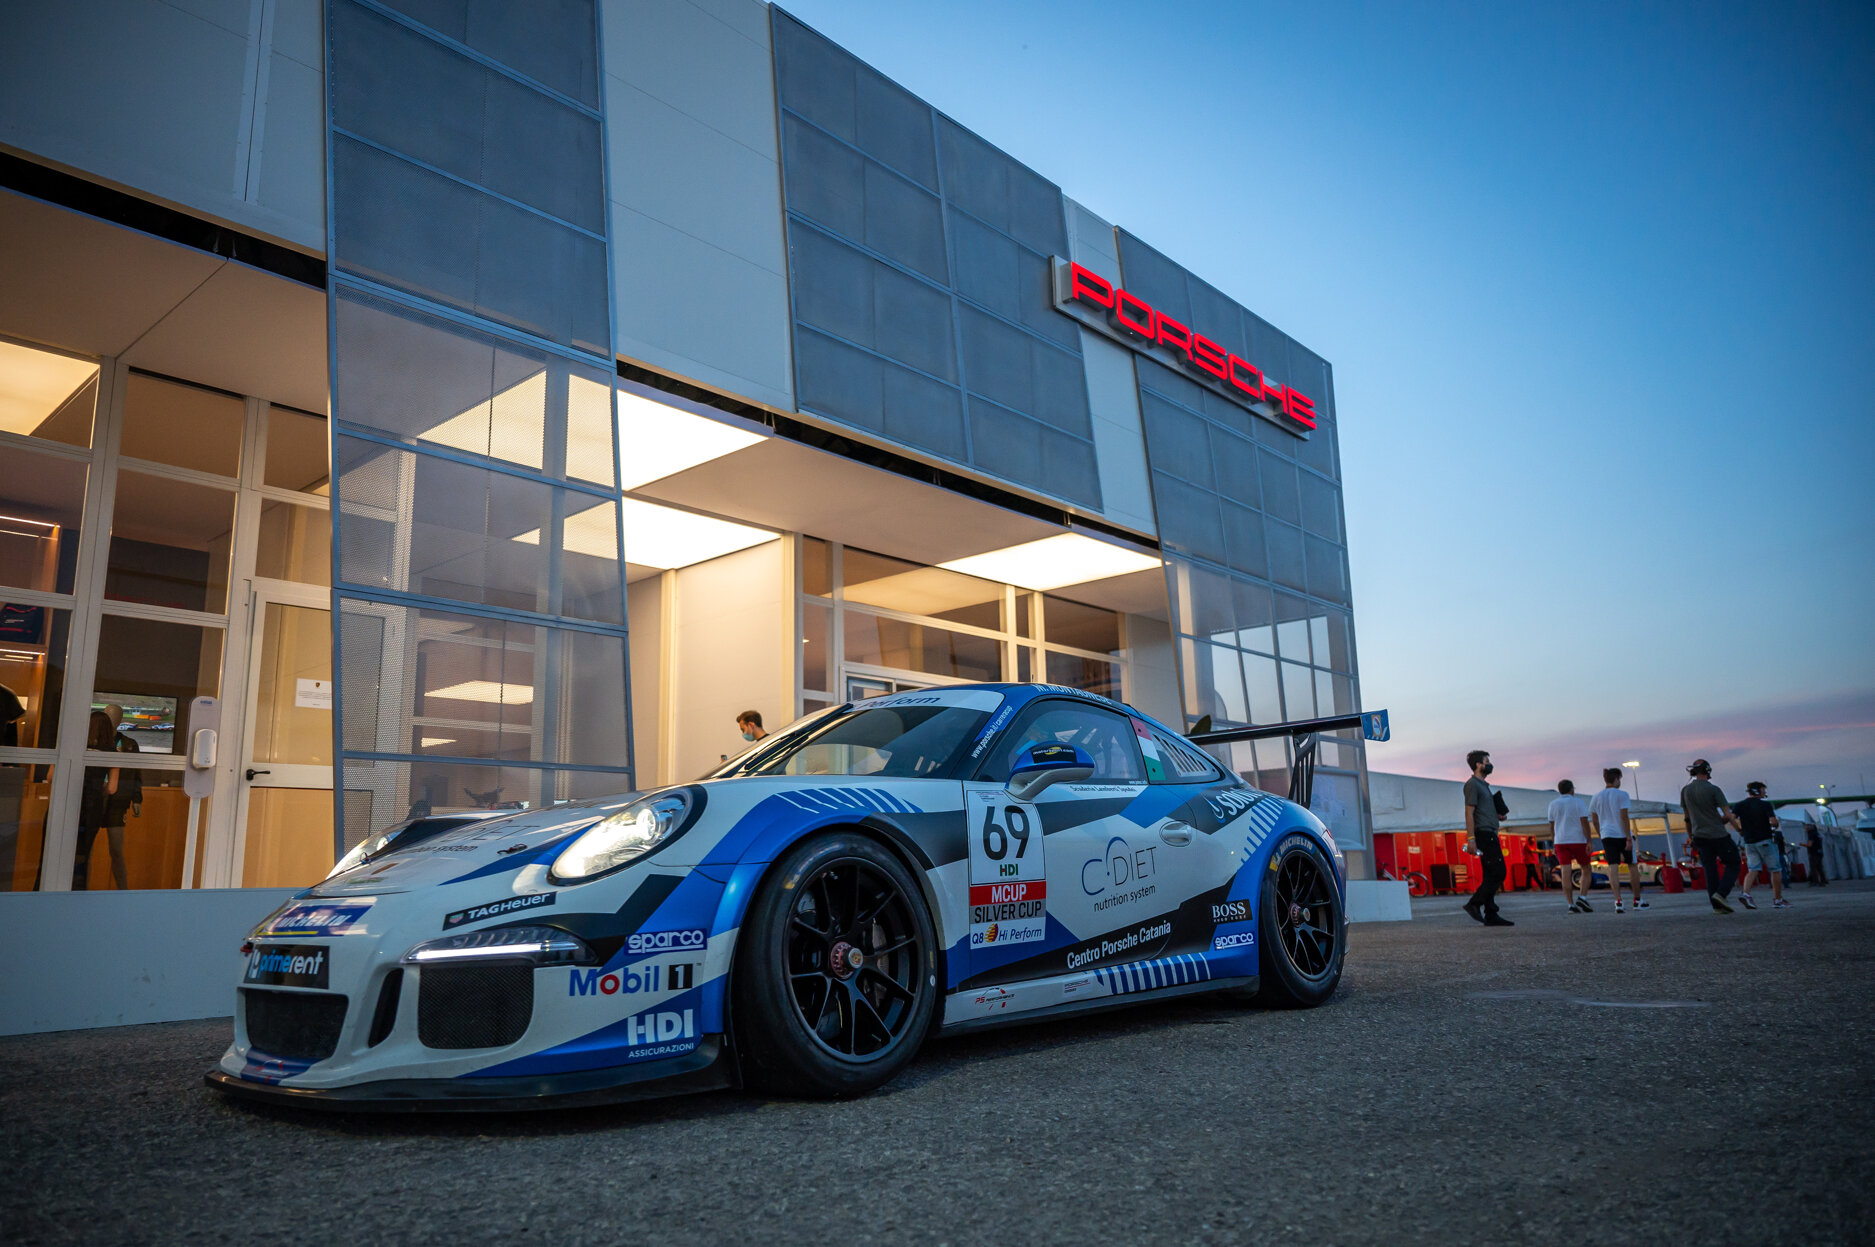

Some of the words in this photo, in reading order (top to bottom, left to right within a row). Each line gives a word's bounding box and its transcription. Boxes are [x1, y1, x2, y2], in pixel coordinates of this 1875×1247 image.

[1071, 261, 1317, 430] PORSCHE
[982, 805, 1030, 861] 69
[1000, 864, 1018, 876] HDI
[992, 884, 1027, 903] MCUP
[1094, 895, 1129, 912] nutrition
[1130, 885, 1156, 903] system
[274, 914, 352, 927] MICHELIN
[974, 904, 1016, 923] SILVER
[1018, 901, 1042, 918] CUP
[1212, 902, 1246, 918] BOSS
[628, 930, 704, 954] sparco
[972, 932, 984, 945] Q8
[998, 930, 1008, 941] Hi
[1010, 927, 1042, 941] Perform
[1067, 946, 1100, 969] Centro
[1102, 933, 1138, 957] Porsche
[1139, 920, 1171, 943] Catania
[1215, 932, 1254, 949] sparco
[569, 965, 660, 997] Mobil
[627, 1009, 694, 1046] HDI
[628, 1043, 694, 1058] ASSICURAZIONI
